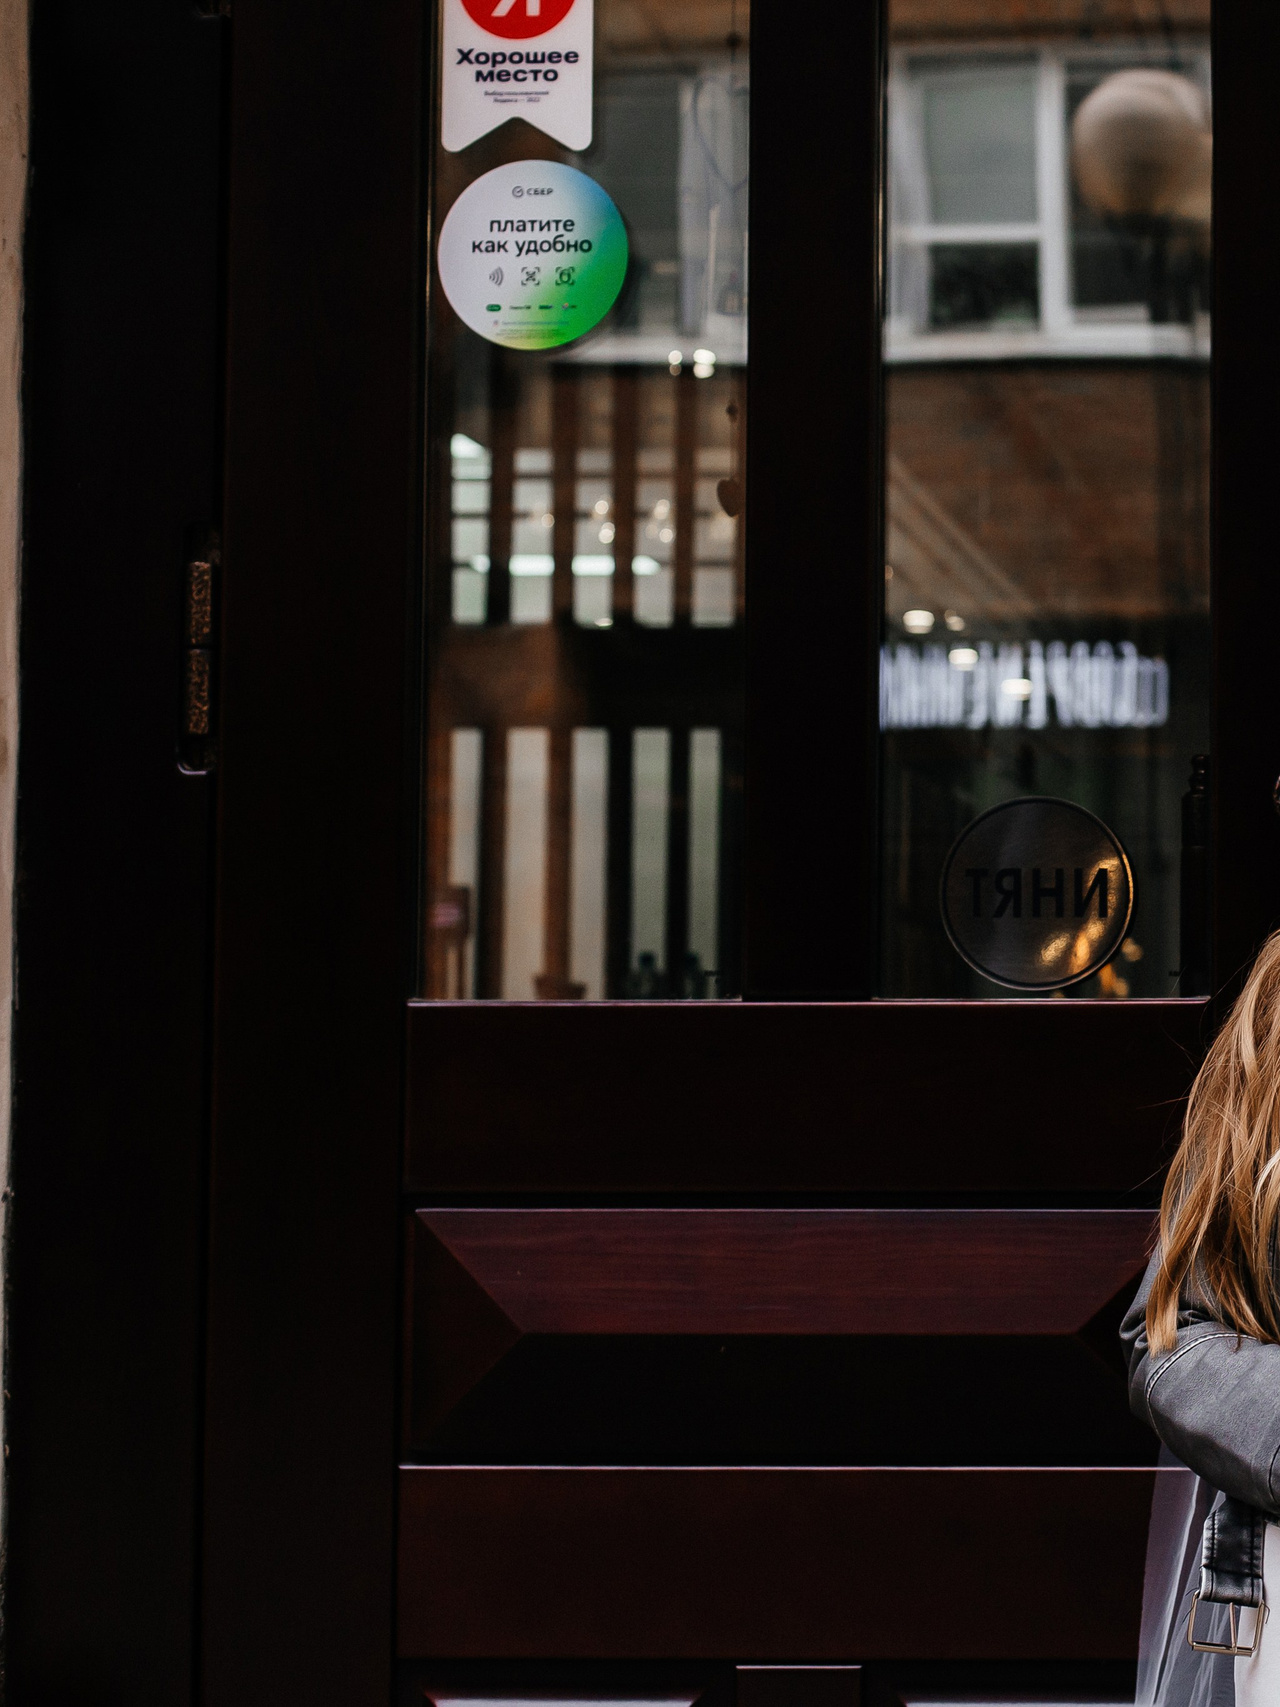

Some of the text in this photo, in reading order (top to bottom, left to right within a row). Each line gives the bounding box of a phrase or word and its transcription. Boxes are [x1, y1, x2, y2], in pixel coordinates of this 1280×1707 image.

[456, 48, 579, 67] Хорошее
[475, 69, 559, 83] место
[489, 218, 576, 233] платите
[471, 234, 593, 257] как удобно
[965, 867, 1109, 919] ТЯНИ
